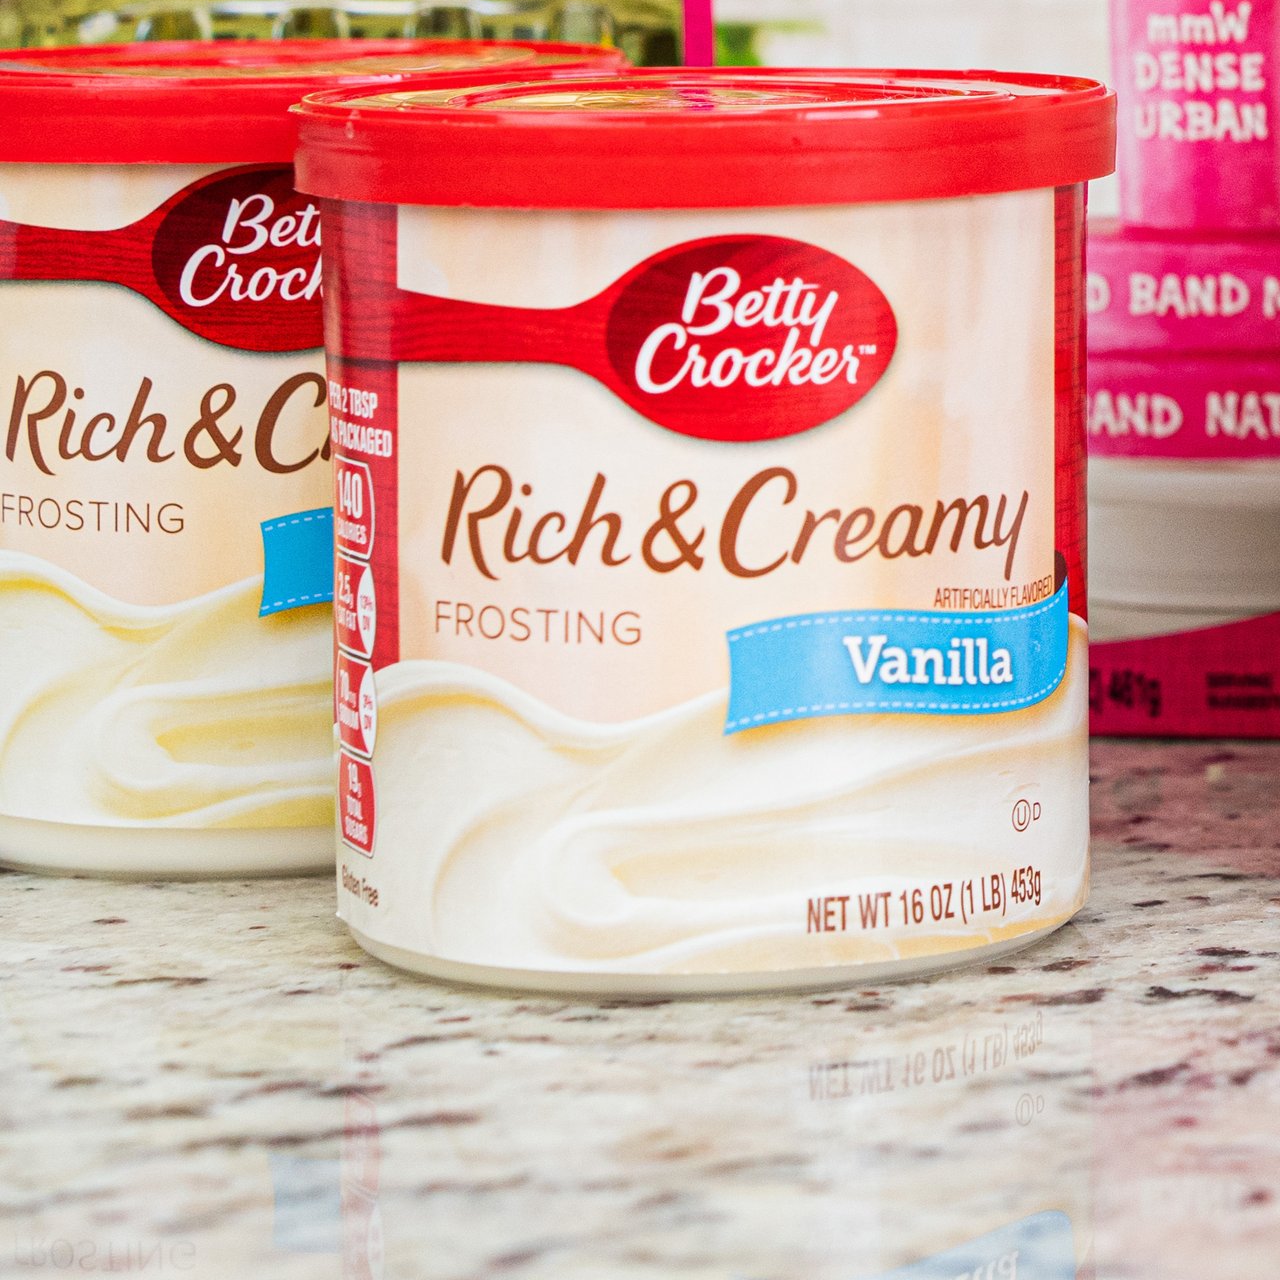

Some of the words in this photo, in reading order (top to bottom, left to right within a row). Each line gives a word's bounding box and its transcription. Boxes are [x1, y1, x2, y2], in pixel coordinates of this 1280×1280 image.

[1147, 1, 1252, 44] mmW
[1134, 51, 1266, 92] DENSE
[1134, 99, 1268, 142] URBAN
[682, 266, 839, 348] Betty
[1129, 272, 1250, 318] BAND
[348, 387, 378, 420] TBSP
[340, 420, 392, 458] PACKAGED
[1, 492, 185, 534] FROSTING
[337, 468, 363, 519] 140
[933, 586, 1009, 609] ARTIFICIALLY
[1011, 574, 1052, 606] FLAVORED
[435, 601, 642, 646] FROSTING
[843, 635, 1013, 686] Vanilla
[807, 895, 850, 934] NET
[858, 891, 892, 930] WT
[899, 888, 924, 925] 16
[930, 883, 955, 922] OZ
[960, 879, 975, 925] (1
[981, 872, 1007, 917] LB)
[1010, 865, 1041, 906] 453g
